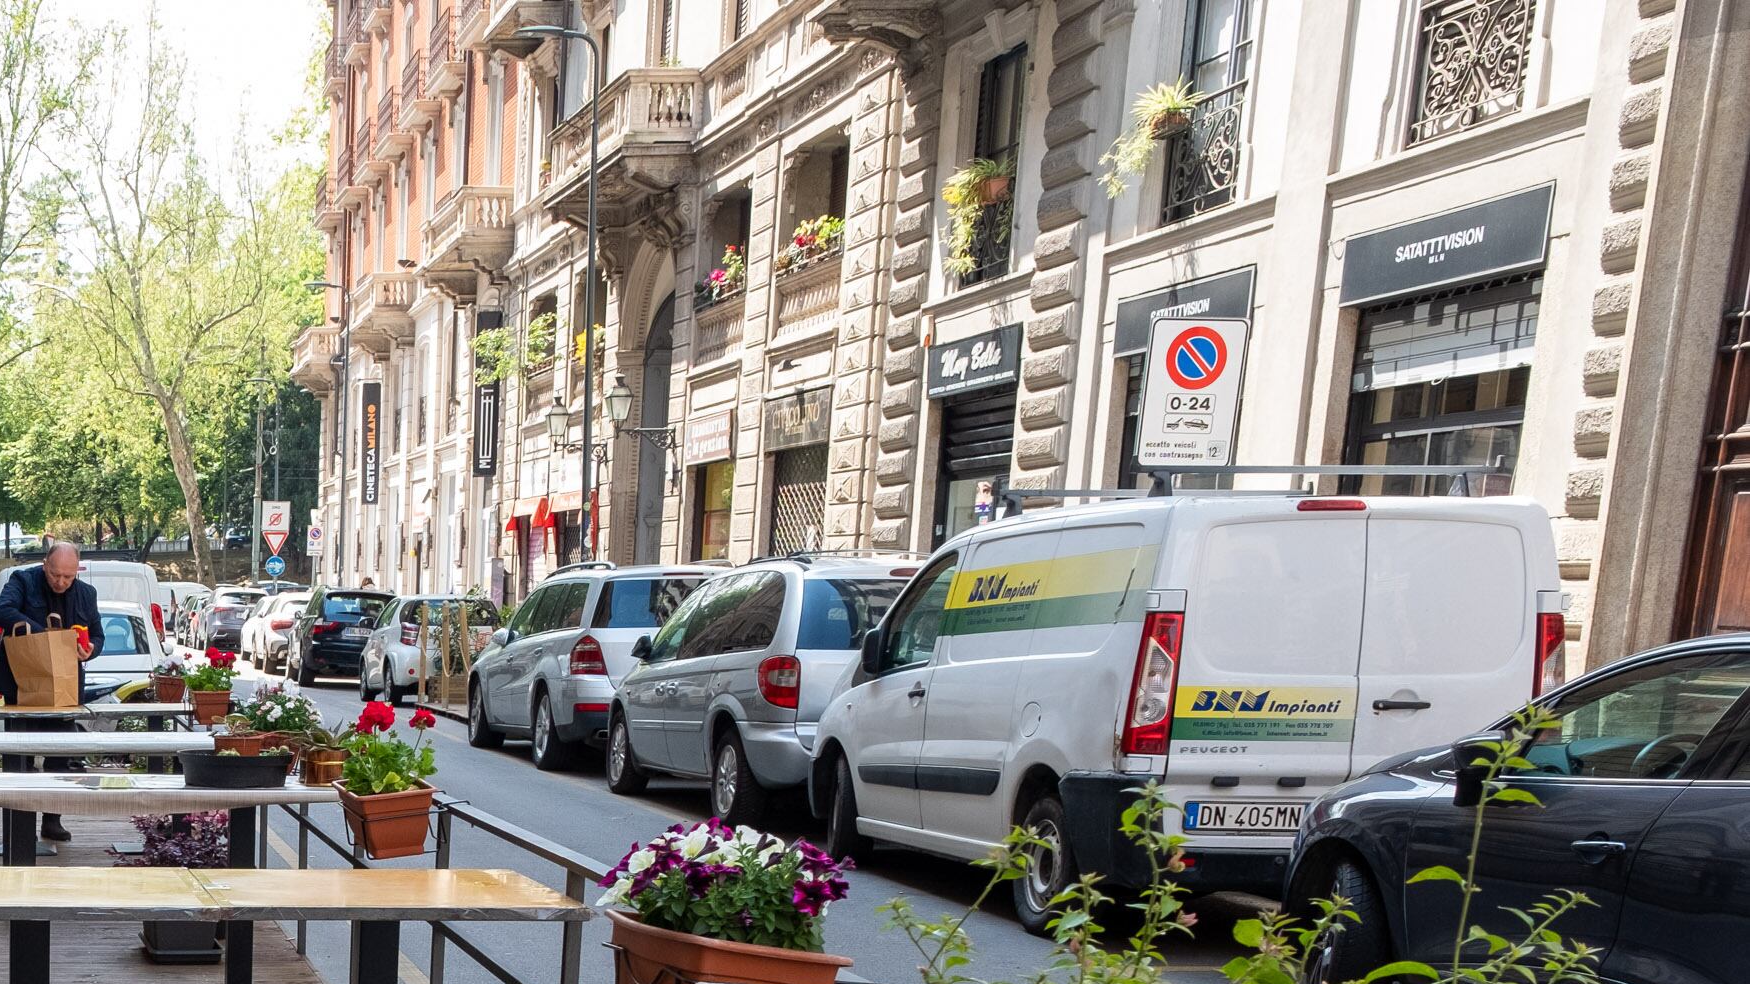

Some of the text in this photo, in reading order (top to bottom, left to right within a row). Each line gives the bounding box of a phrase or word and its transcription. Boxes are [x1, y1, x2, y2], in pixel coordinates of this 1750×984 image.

[1170, 396, 1210, 411] 0-24
[1001, 579, 1041, 601] Impianti
[1268, 700, 1342, 715] Impianti
[1179, 746, 1248, 754] PEUGEOT
[1200, 806, 1302, 828] DN 405MN
